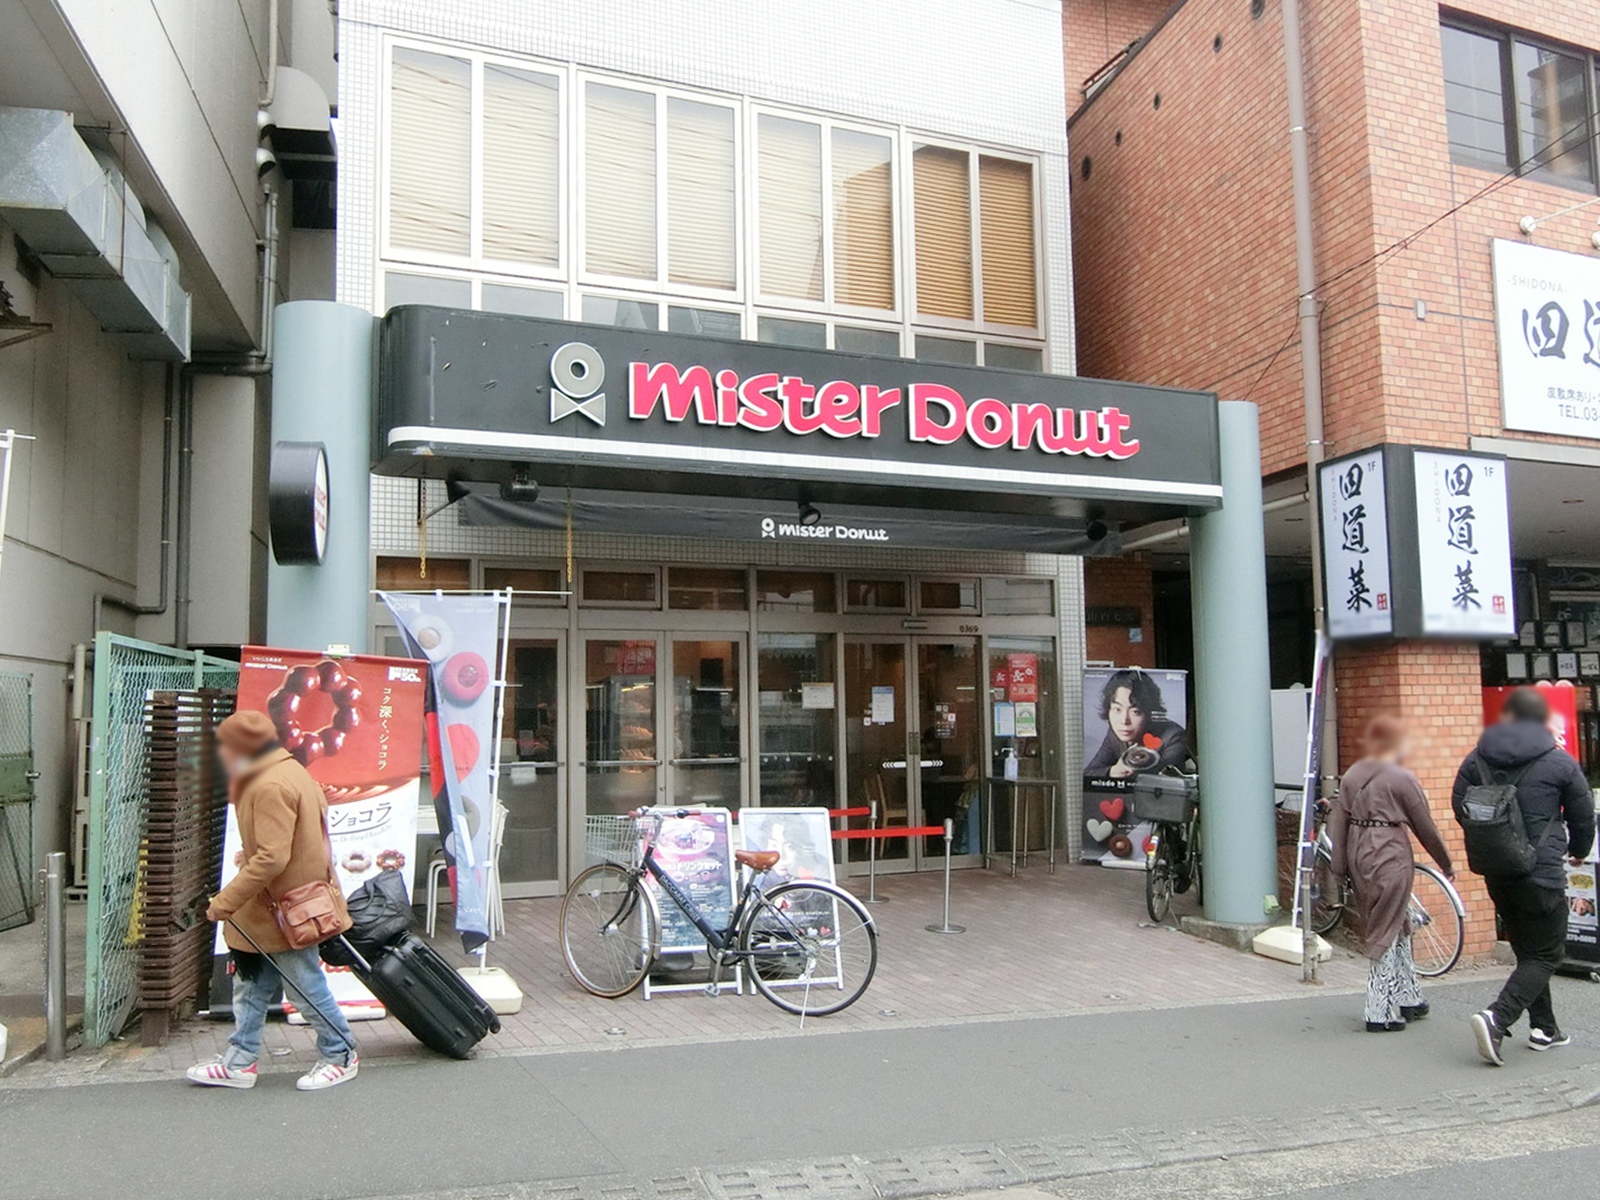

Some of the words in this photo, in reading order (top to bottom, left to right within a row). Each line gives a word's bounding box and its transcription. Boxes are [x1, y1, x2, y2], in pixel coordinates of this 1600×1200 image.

[908, 382, 1140, 461] Donut
[1367, 461, 1377, 473] 1F
[1484, 466, 1495, 478] 1F
[835, 525, 889, 541] Donut
[1339, 462, 1373, 614] 四道菜
[1444, 462, 1482, 614] 四道菜
[959, 625, 979, 633] 0369
